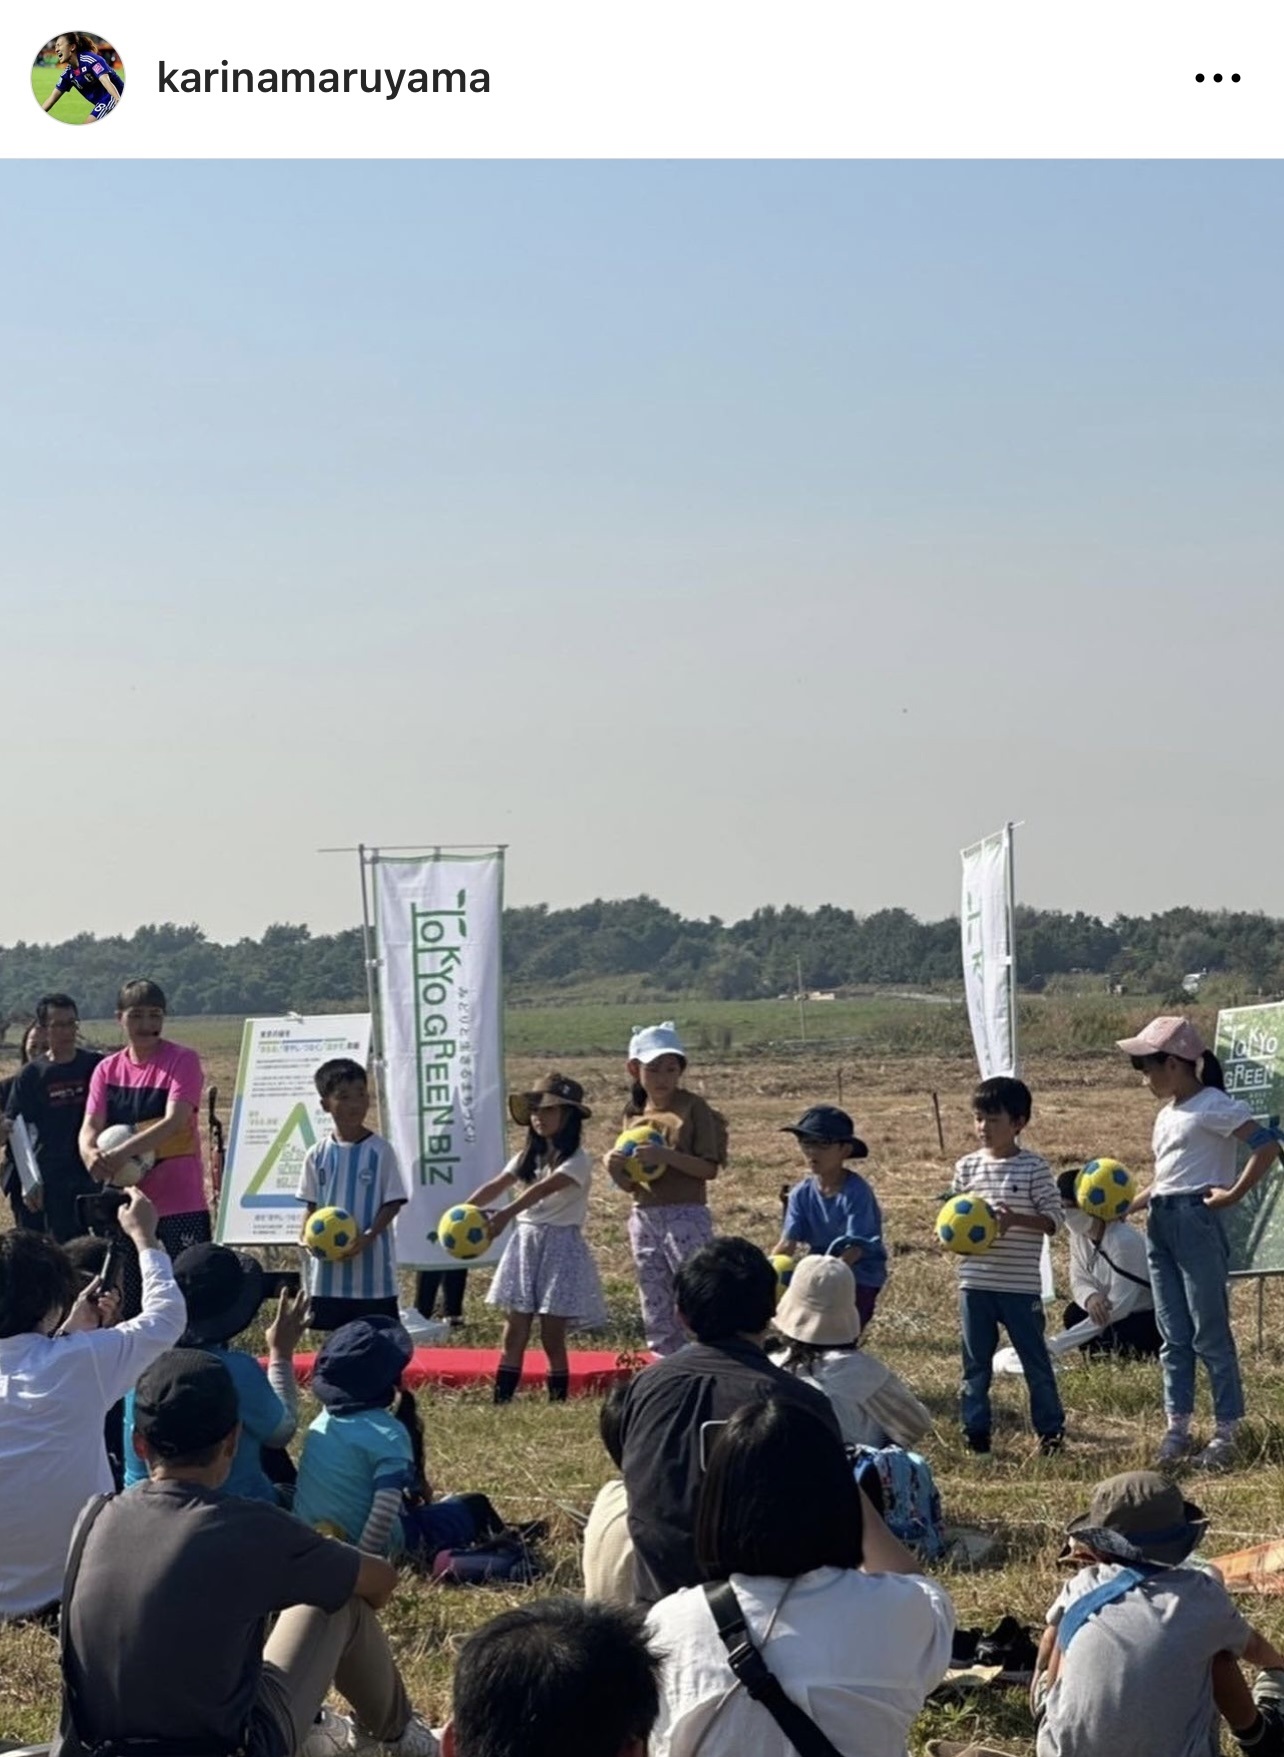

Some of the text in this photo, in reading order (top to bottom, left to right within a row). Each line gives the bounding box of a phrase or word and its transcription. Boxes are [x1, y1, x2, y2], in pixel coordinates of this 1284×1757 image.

[415, 889, 466, 1185] TOKYO GREEN BIZ
[1223, 1023, 1278, 1062] TOKYO
[1224, 1064, 1275, 1090] GREEN
